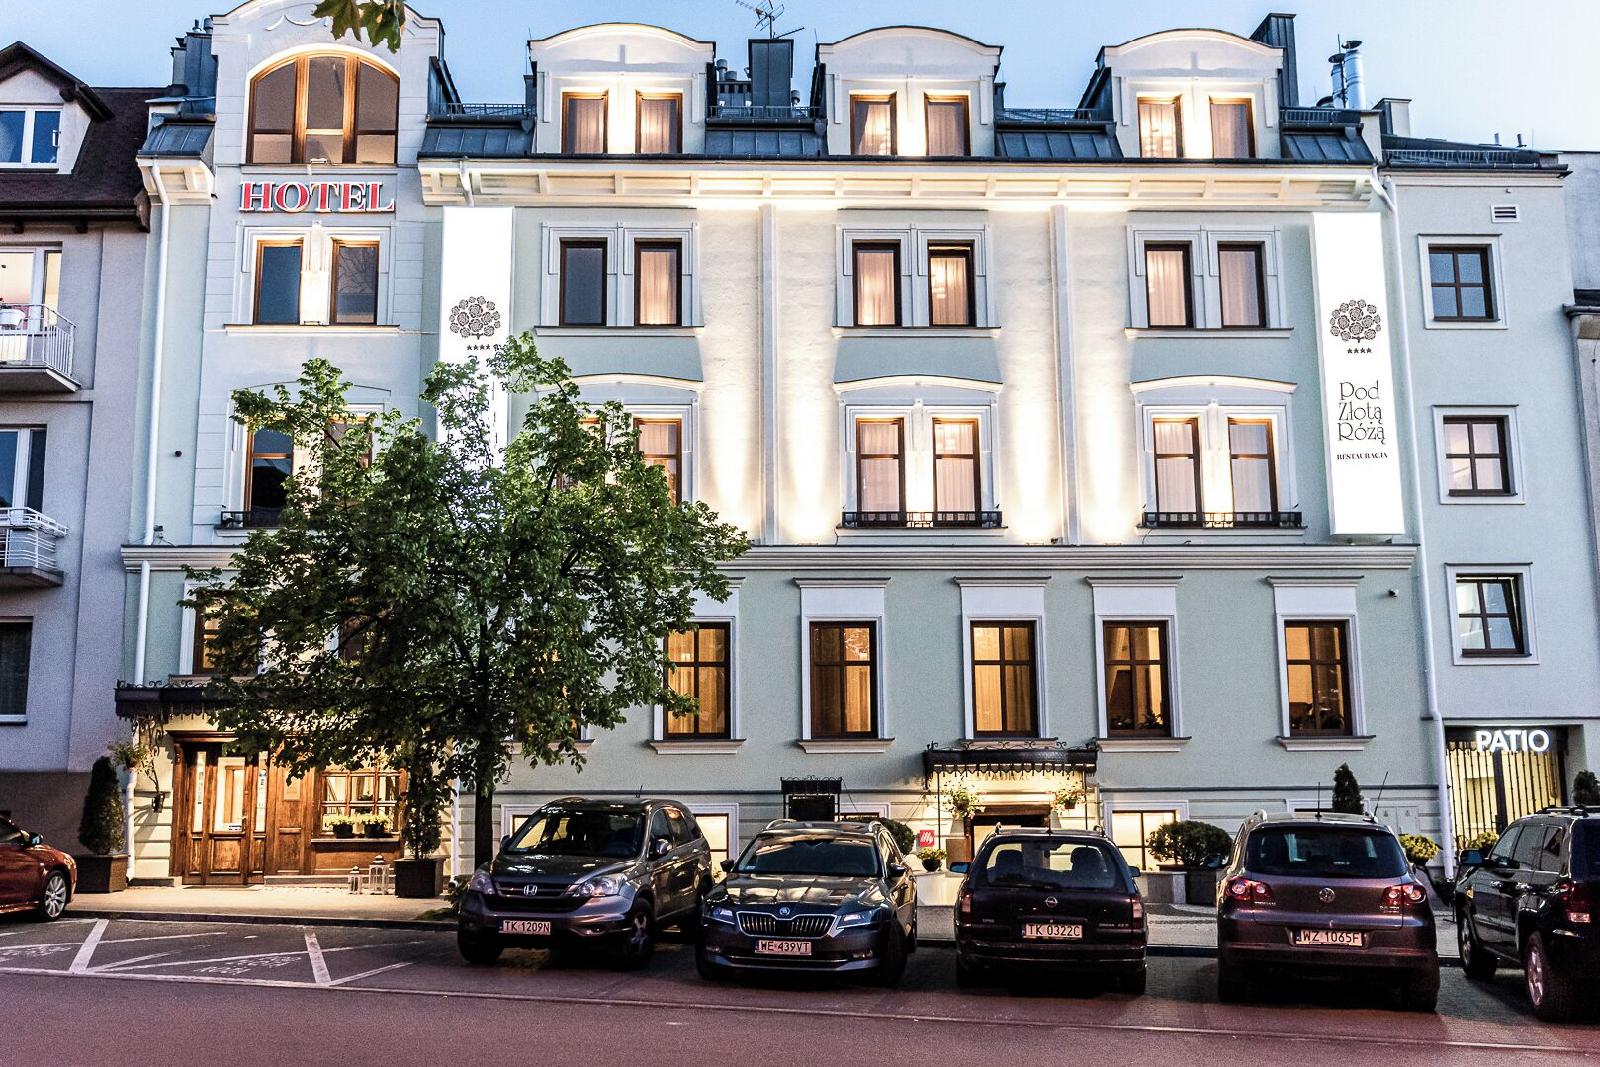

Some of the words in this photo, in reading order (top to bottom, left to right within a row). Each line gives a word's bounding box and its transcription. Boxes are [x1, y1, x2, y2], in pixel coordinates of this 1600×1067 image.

[239, 181, 395, 213] HOTEL
[1340, 380, 1379, 400] Pod
[1339, 401, 1383, 424] Złotą
[1337, 422, 1386, 445] Różą
[1337, 452, 1387, 460] RESTAURACJA
[1475, 729, 1550, 753] PATIO
[920, 831, 934, 845] illy
[505, 921, 517, 931] TK
[522, 921, 550, 932] 1209N
[1028, 924, 1043, 935] TK
[1047, 925, 1081, 936] 0322C
[1303, 930, 1320, 941] WZ
[1325, 931, 1359, 943] 1065F
[760, 941, 775, 952] WE
[777, 942, 810, 953] 439VT
